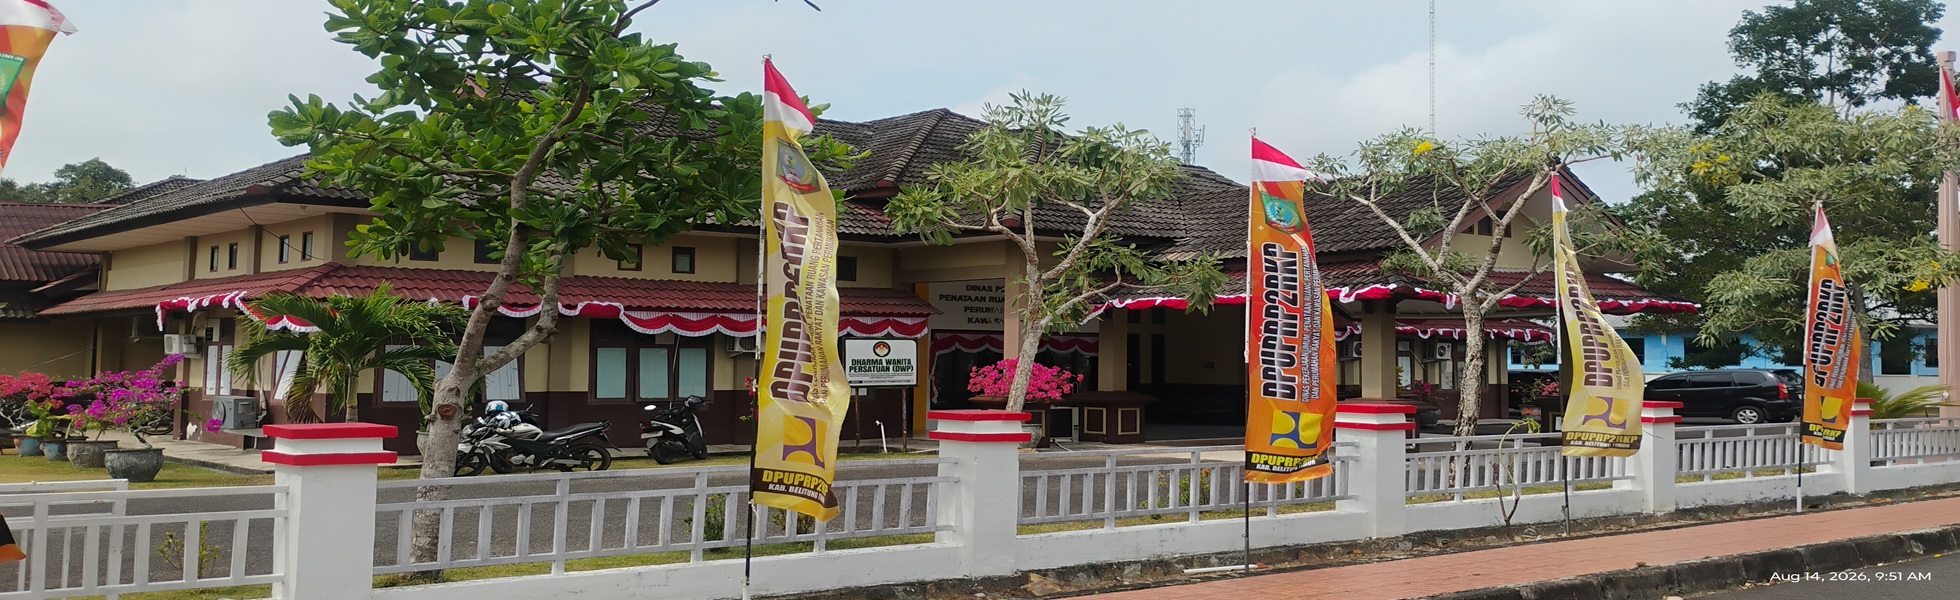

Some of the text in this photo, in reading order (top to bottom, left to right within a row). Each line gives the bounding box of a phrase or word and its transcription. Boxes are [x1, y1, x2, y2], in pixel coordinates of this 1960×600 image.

[812, 212, 825, 255] PERTANAHAN
[822, 218, 835, 265] PERMUKIMAN
[808, 256, 820, 280] RUANG
[1301, 246, 1311, 281] PERTANAHAN
[816, 264, 830, 300] KAWASAN
[966, 284, 993, 292] DINAS
[1304, 282, 1312, 303] RUANG
[804, 281, 815, 319] PENATAAN
[814, 300, 825, 317] DAN
[939, 294, 986, 302] PENATAAN
[1313, 287, 1322, 314] KAWASAN
[1260, 242, 1299, 401] DPUPRP2RKP
[1303, 304, 1312, 332] PENATAAN
[1313, 315, 1322, 328] DAN
[814, 318, 823, 346] RAKYAT
[1311, 329, 1321, 351] RAKYAT
[816, 347, 831, 387] PERUMAHAN
[849, 364, 914, 373] PERSATUAN (DWP)
[851, 358, 912, 366] DHARMA WANITA
[1301, 353, 1311, 385] PEKERJAAN
[1311, 352, 1320, 386] PERUMAHAN
[1301, 385, 1311, 403] DINAS
[1311, 387, 1320, 399] DAN
[1565, 431, 1638, 444] DPUPRP2RKP
[1256, 463, 1271, 471] KAB.
[768, 483, 787, 492] KAB.
[789, 486, 818, 499] BELITUNG
